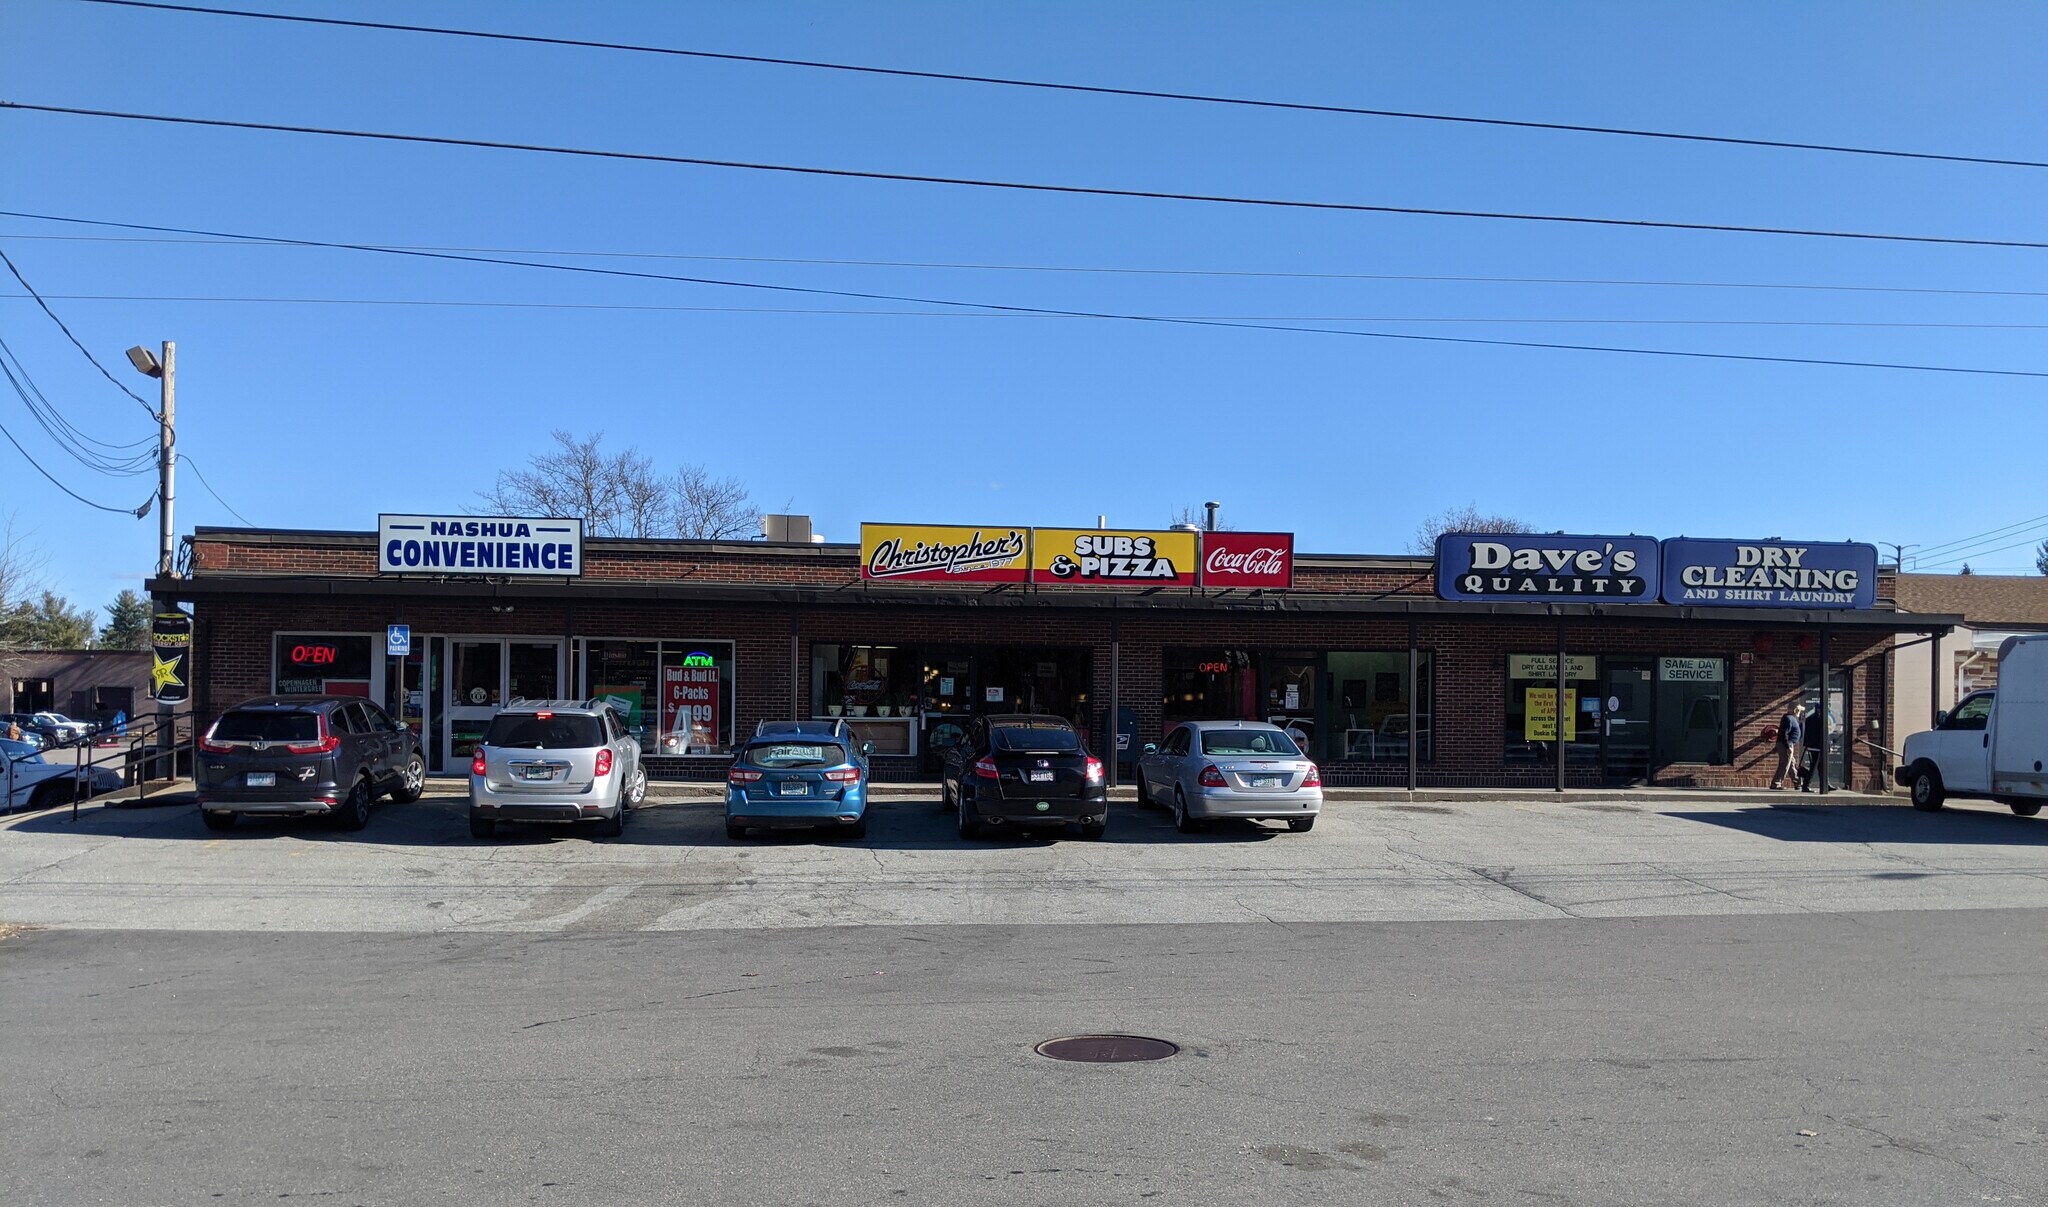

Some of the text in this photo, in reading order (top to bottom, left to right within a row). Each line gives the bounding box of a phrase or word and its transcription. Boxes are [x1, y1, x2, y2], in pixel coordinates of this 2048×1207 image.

[430, 521, 531, 537] NASHUA
[386, 539, 573, 569] CONVENIENCE
[869, 530, 1024, 576] Christopher's
[1075, 536, 1153, 557] SUBS
[989, 557, 1014, 568] 1977
[1206, 547, 1287, 574] Coca-Cola
[1470, 542, 1637, 572] Dave's
[1737, 546, 1808, 567] DRY
[1050, 556, 1175, 578] & PIZZA
[1464, 575, 1637, 593] QUALITY
[1682, 566, 1859, 590] CLEANING
[1684, 589, 1856, 603] AND SHIRT LAUNDRY
[291, 645, 336, 663] OPEN
[683, 655, 713, 667] ATM
[1199, 662, 1228, 672] OPEN
[1665, 659, 1718, 669] SAME DAY
[667, 669, 718, 682] Bud & Bud Lt.
[1669, 670, 1714, 679] SERVICE
[279, 679, 317, 687] COPENHAGEN
[285, 685, 322, 693] WINTERGREE
[674, 685, 709, 700] 6-Packs
